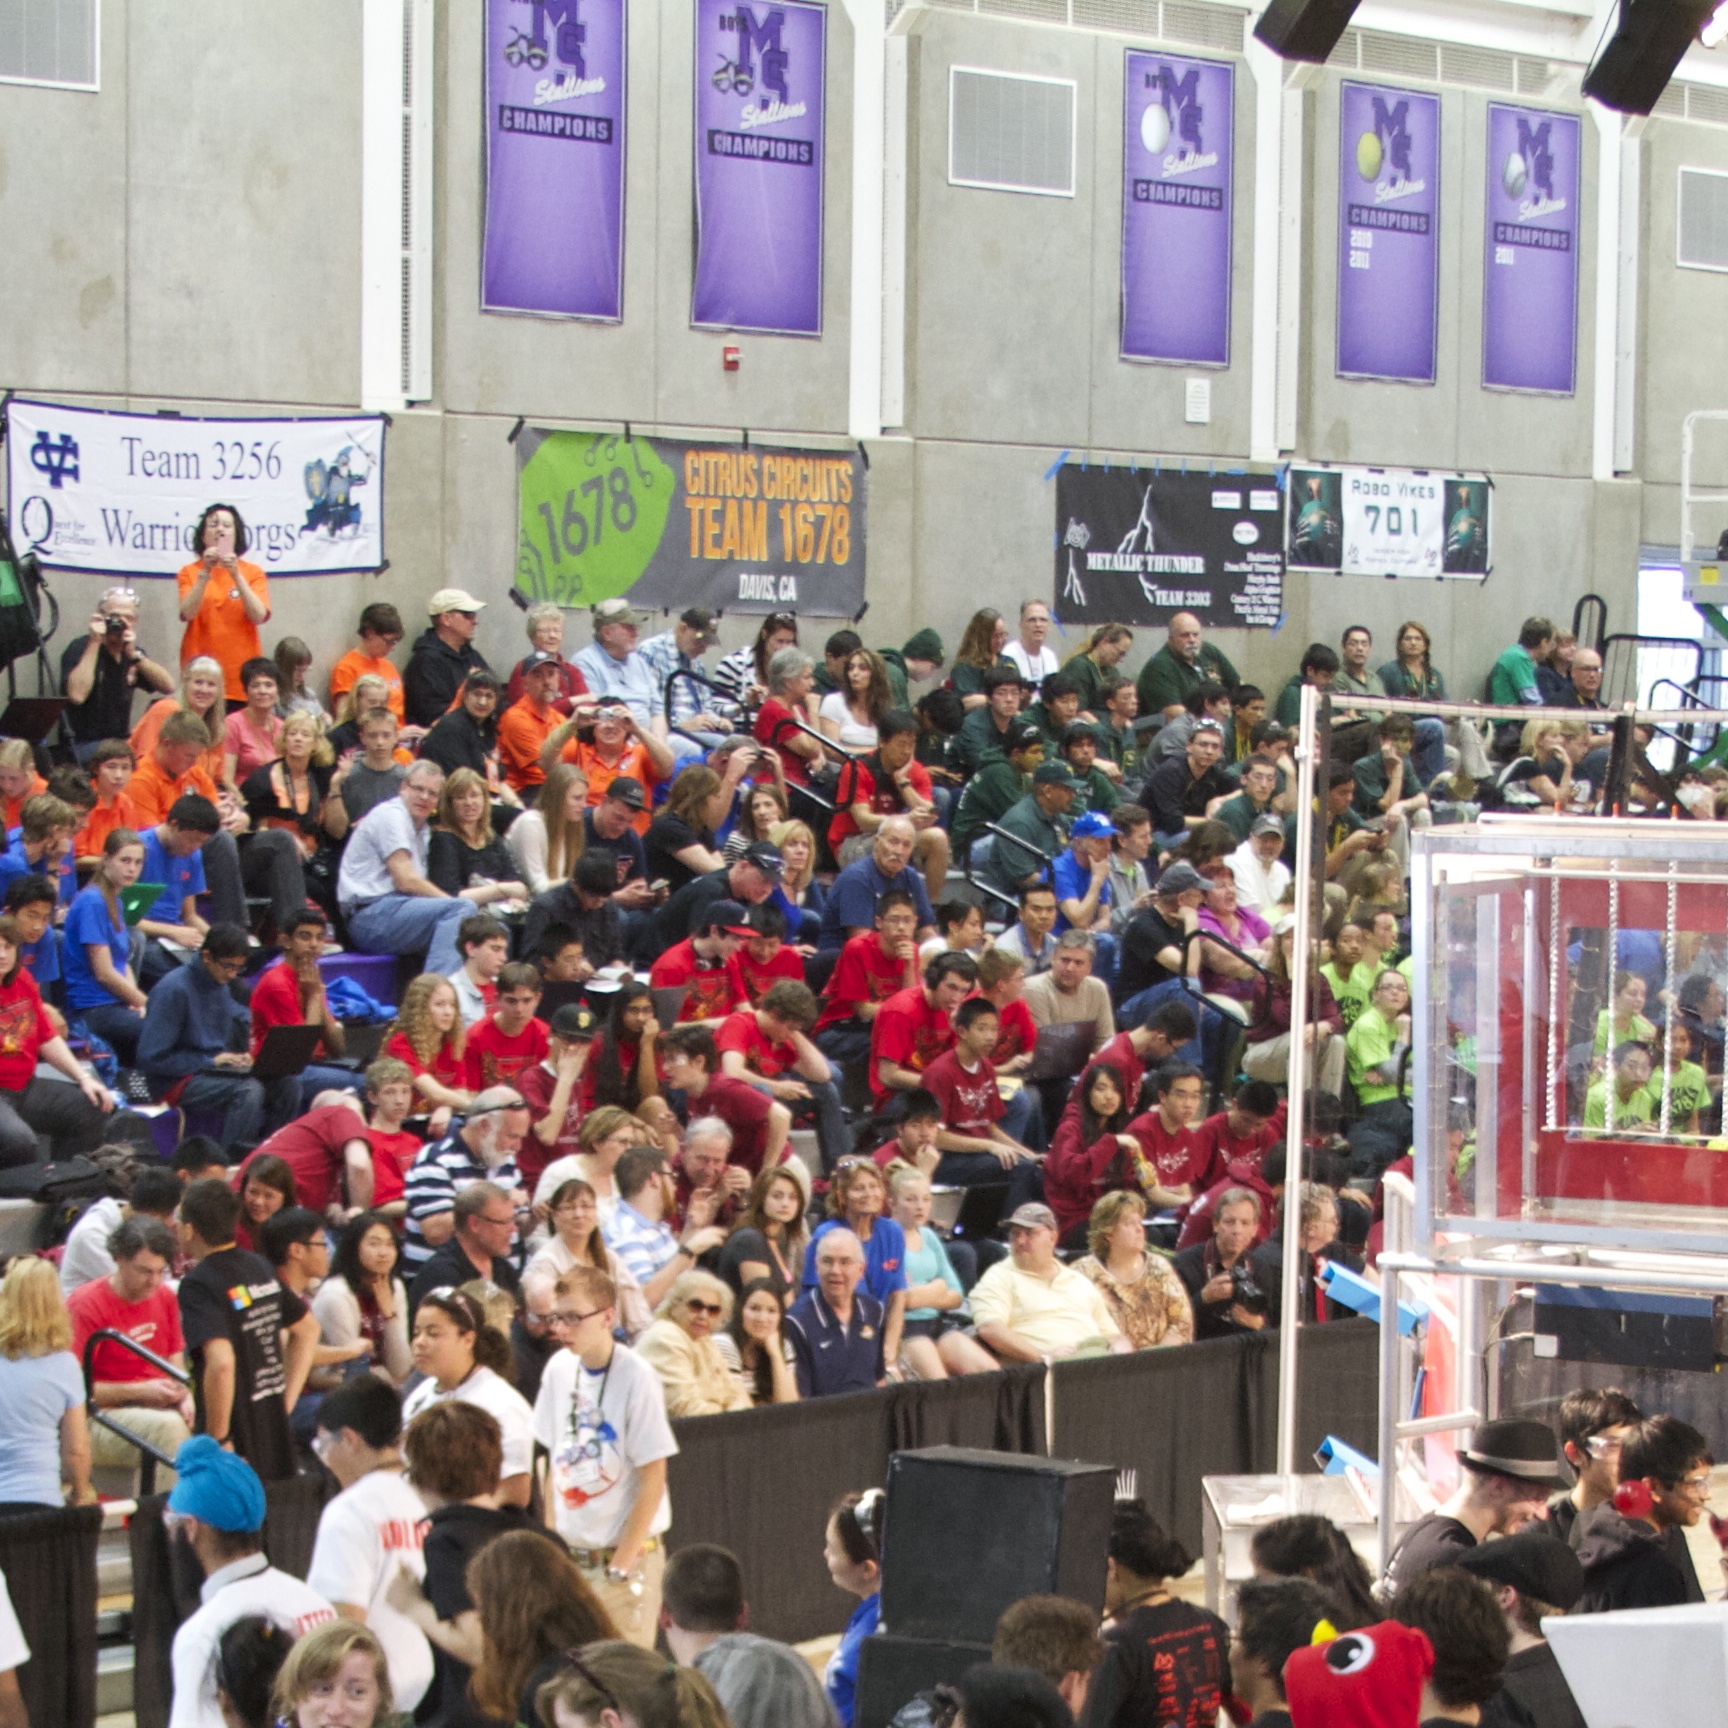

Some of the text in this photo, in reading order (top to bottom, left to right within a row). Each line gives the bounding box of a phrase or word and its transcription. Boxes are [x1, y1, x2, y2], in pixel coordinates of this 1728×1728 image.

[535, 76, 606, 106] Stallions
[501, 108, 612, 142] CHAMPIONS
[740, 101, 807, 130] Stallions
[713, 131, 813, 166] CHAMPIONS
[1350, 206, 1429, 234] CHAMPIONS
[1349, 230, 1373, 250] 2010
[1495, 226, 1571, 251] CHAMPIONS
[1349, 251, 1370, 270] 2011
[1495, 247, 1515, 266] 2011
[121, 436, 282, 480] Team 3256
[683, 450, 854, 504] CITRUS CIRCUITS
[1352, 479, 1436, 500] ROBO VIKES
[538, 466, 637, 566] 1678
[1364, 504, 1419, 538] 701
[683, 496, 850, 566] TEAM 1678
[1086, 552, 1206, 575] METALLIC THUNDER
[738, 572, 798, 604] DAVIS, CA
[1154, 590, 1184, 607] TEAM
